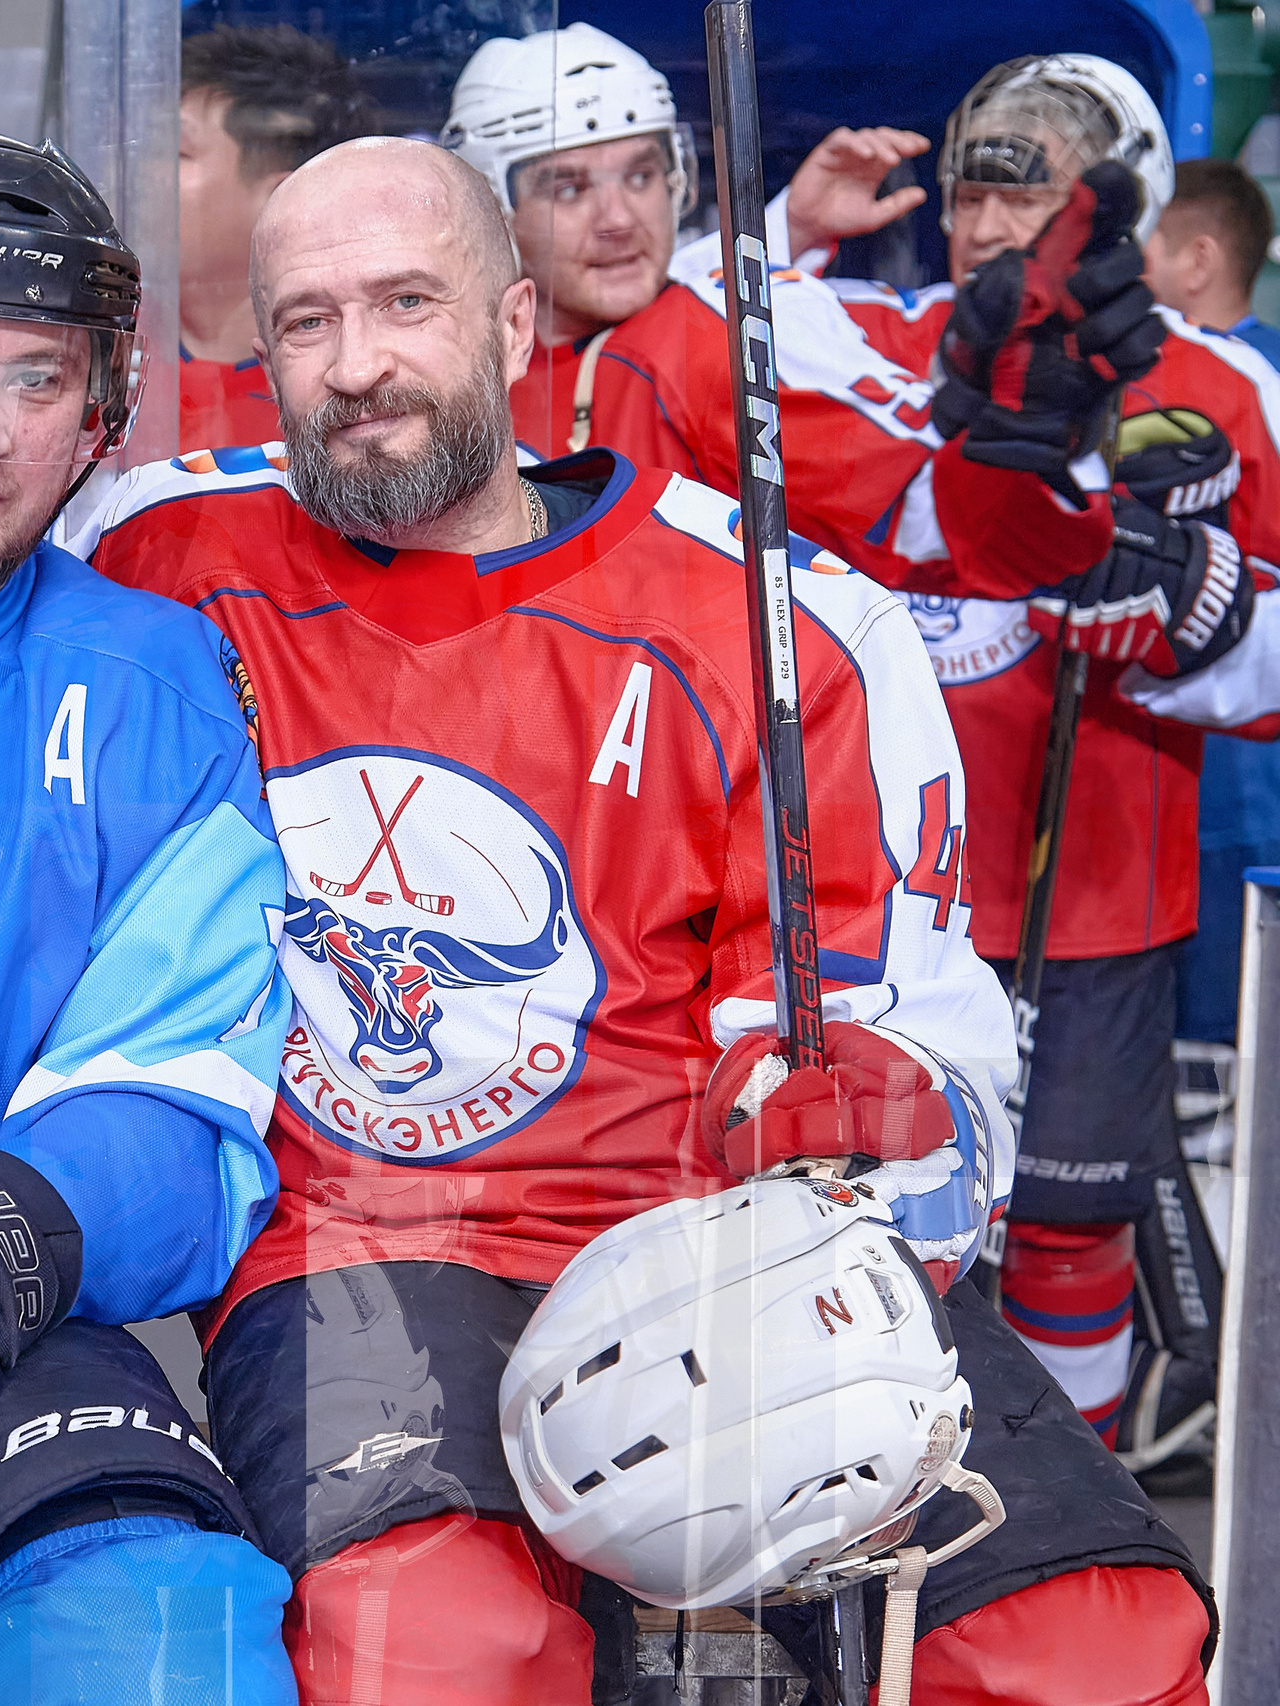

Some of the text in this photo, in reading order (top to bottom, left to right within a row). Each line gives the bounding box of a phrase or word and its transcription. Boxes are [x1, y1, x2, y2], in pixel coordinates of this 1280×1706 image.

[734, 232, 785, 488] CCM
[774, 576, 783, 589] 85
[776, 598, 786, 622] FLEX
[778, 626, 787, 649] GRIP
[780, 660, 790, 680] P29
[43, 683, 87, 804] A
[588, 660, 653, 798] A
[782, 806, 824, 1071] JETSPEE
